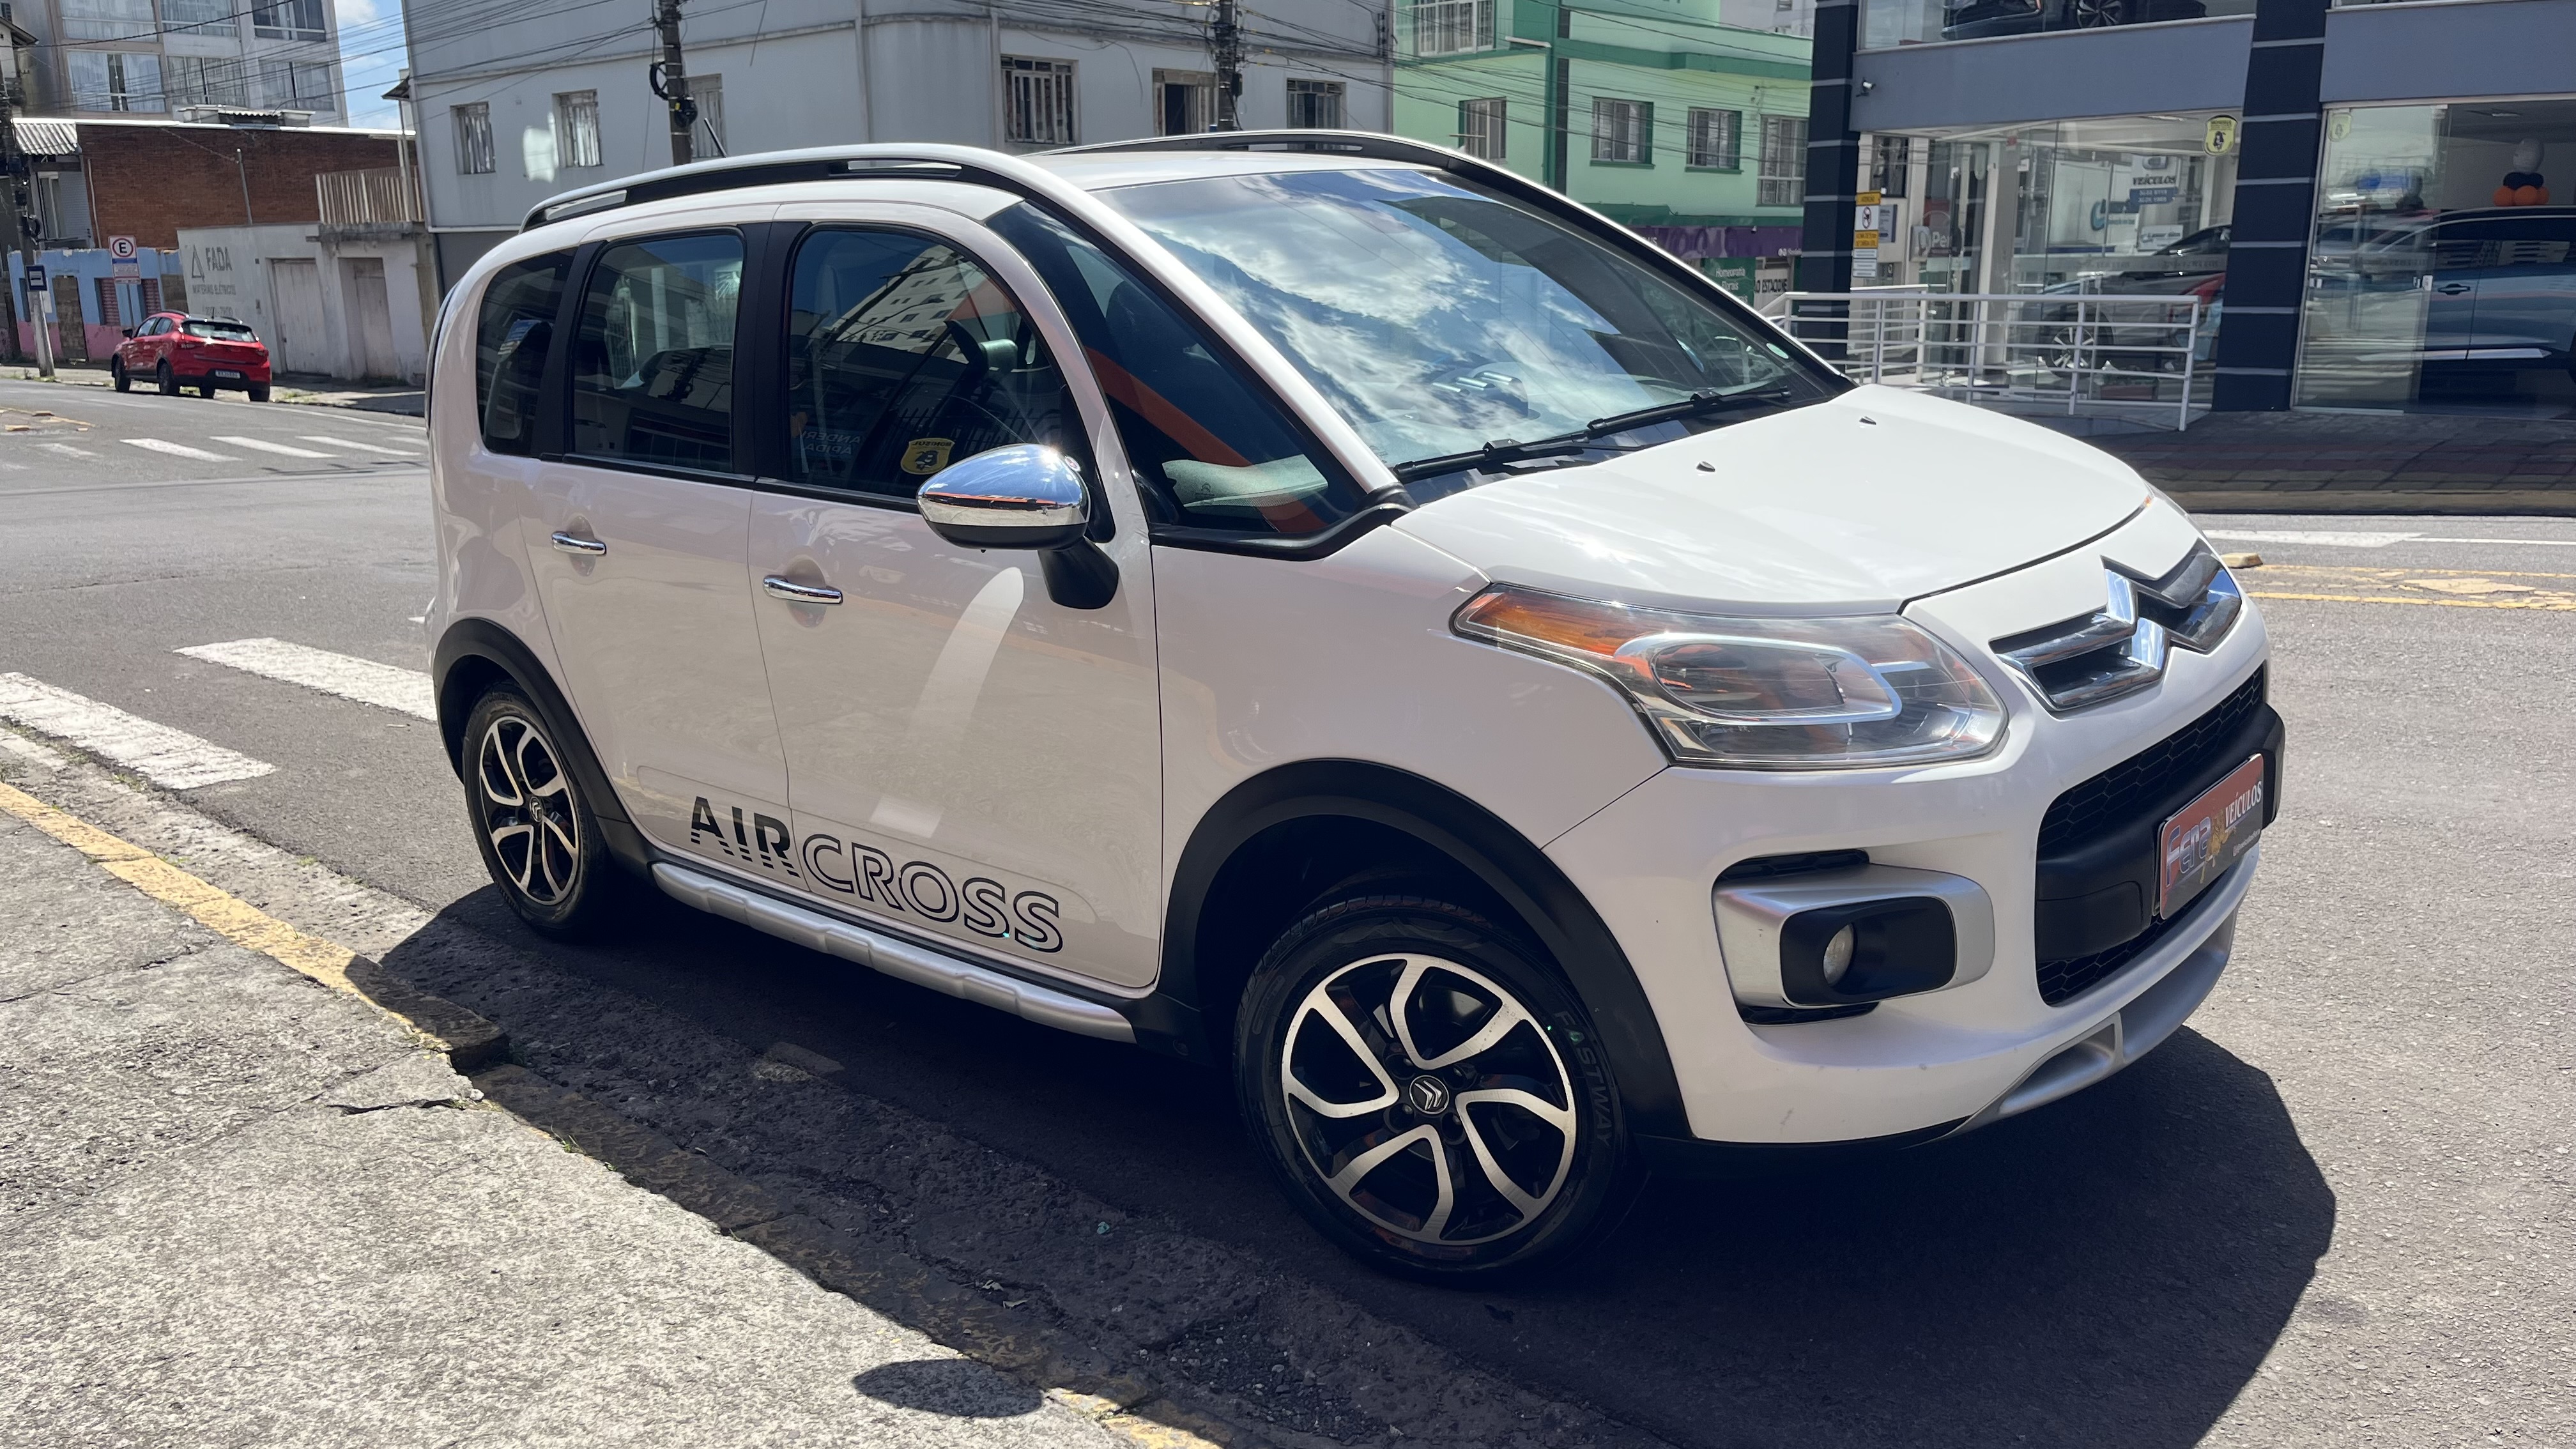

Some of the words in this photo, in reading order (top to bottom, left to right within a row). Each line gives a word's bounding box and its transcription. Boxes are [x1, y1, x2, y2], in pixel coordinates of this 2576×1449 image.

[119, 241, 128, 254] E
[205, 247, 233, 271] FADA
[2225, 781, 2262, 828] VEÍCULOS
[691, 795, 1064, 953] AIRCROSS
[1554, 1010, 1613, 1147] FASTWAY
